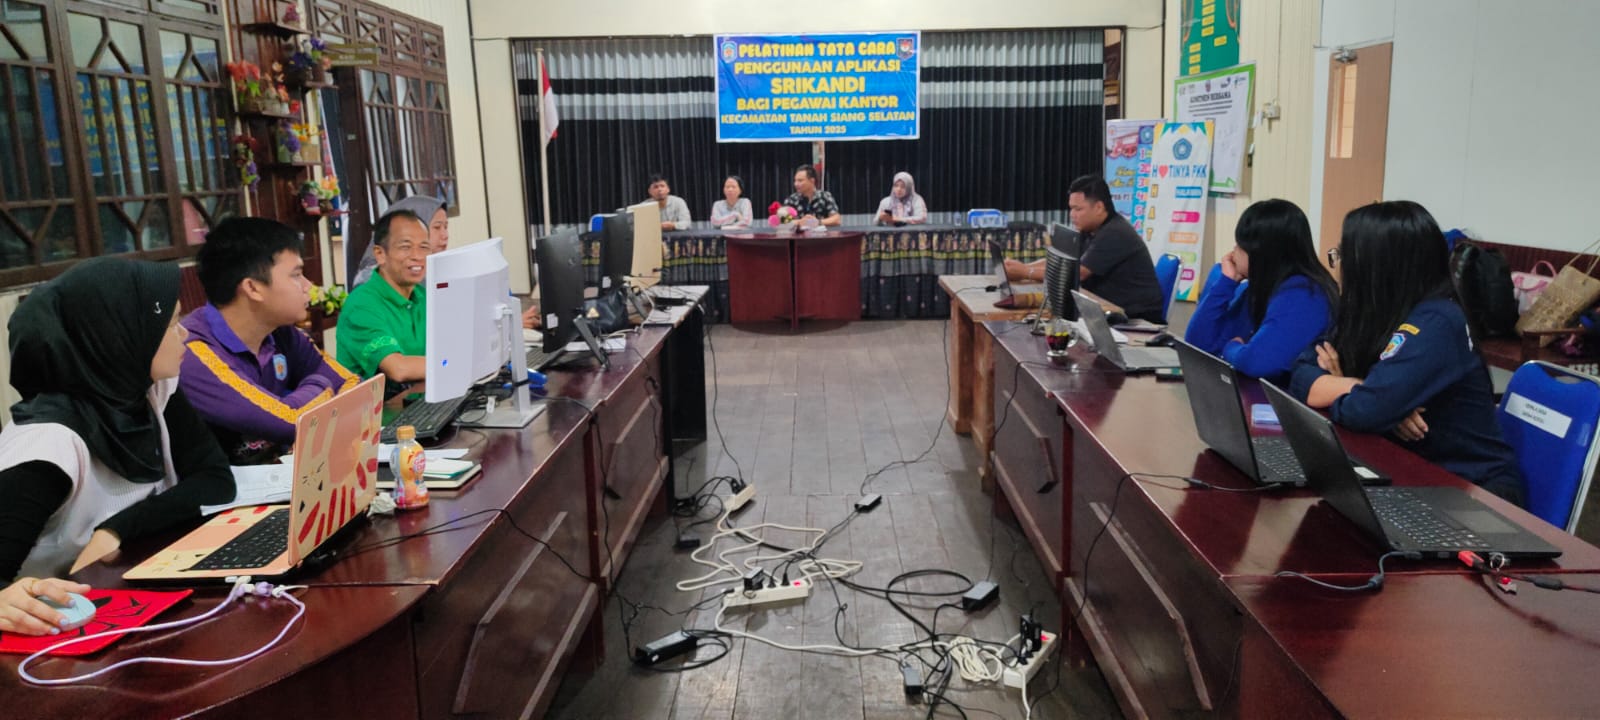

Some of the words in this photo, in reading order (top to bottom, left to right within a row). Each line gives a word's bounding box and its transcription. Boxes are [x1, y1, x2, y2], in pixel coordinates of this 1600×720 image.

[739, 43, 814, 57] PELATIHAN
[817, 42, 855, 56] TATA
[858, 41, 896, 55] CARA
[734, 61, 832, 74] PENGGUNAAN
[835, 59, 901, 72] APLIKASI
[770, 76, 865, 94] SRIKANDI
[736, 98, 770, 111] BAGI
[772, 96, 836, 110] PEGAWAI
[839, 95, 899, 108] KANTOR
[721, 113, 787, 124] KECAMATAN
[790, 112, 828, 122] TANAH
[831, 111, 866, 122] SIANG
[869, 111, 915, 121] SELATAN
[790, 126, 822, 134] TAHUN
[824, 125, 847, 134] 2025
